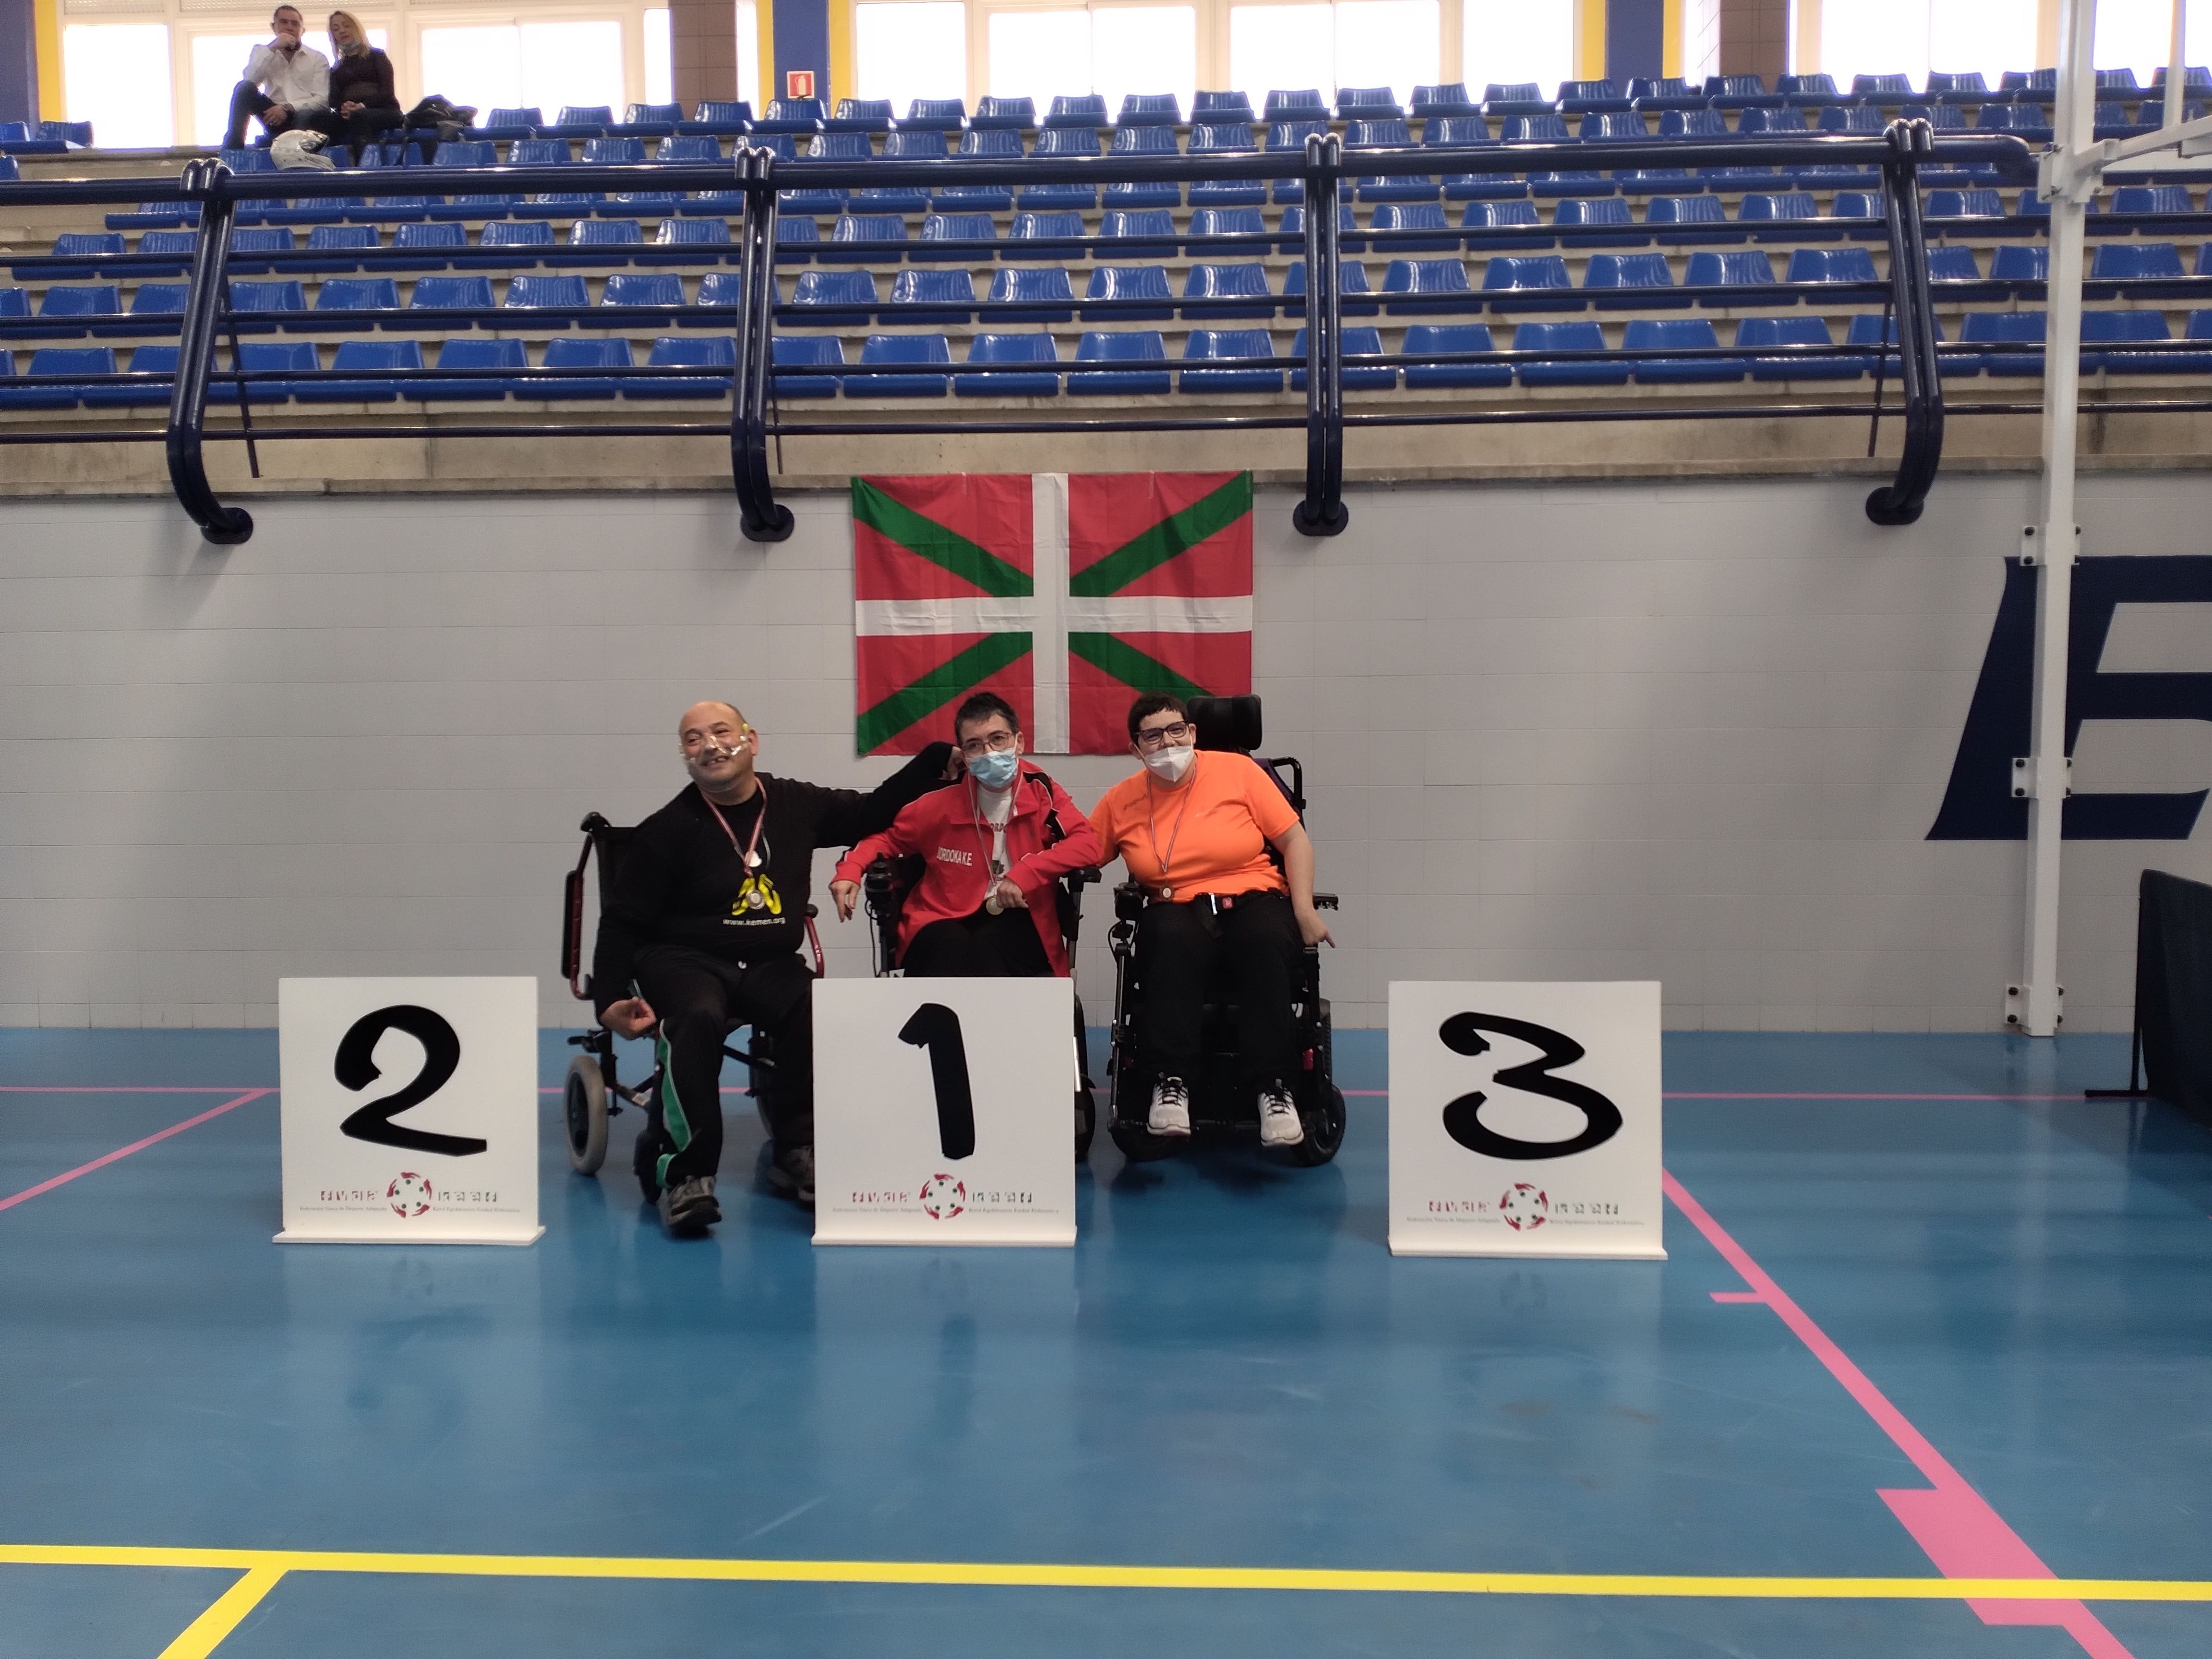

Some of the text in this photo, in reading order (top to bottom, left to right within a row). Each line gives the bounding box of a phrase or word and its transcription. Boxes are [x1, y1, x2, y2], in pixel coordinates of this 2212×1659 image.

[334, 1004, 487, 1157] 2
[897, 1002, 975, 1160] 1
[1439, 1011, 1623, 1160] 3
